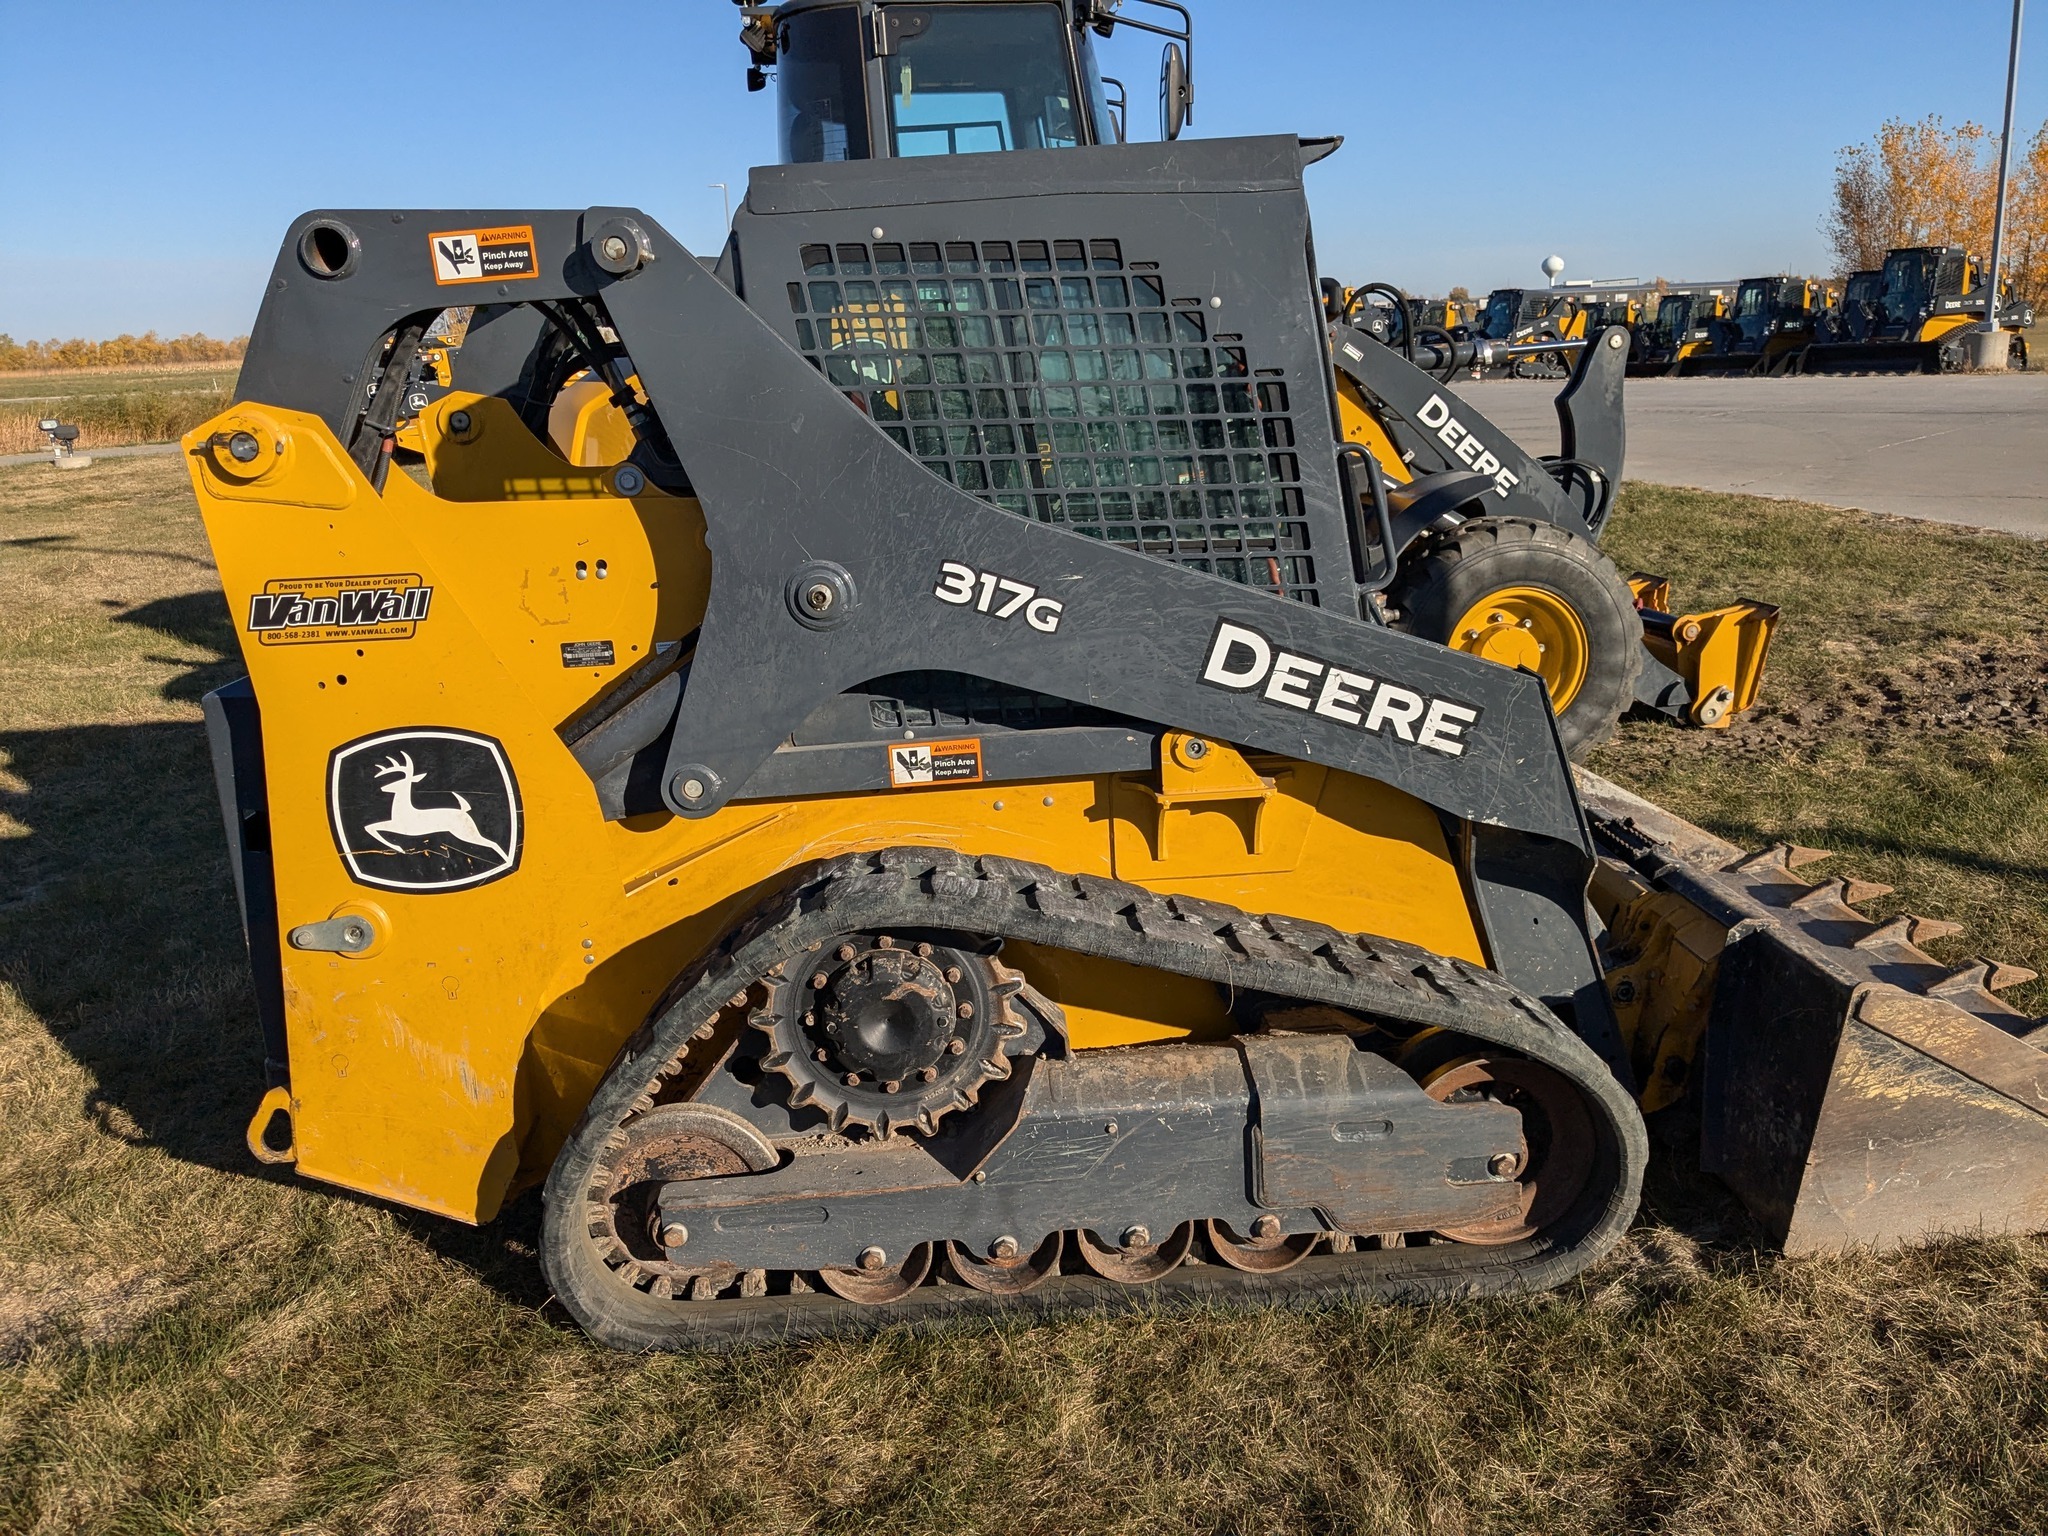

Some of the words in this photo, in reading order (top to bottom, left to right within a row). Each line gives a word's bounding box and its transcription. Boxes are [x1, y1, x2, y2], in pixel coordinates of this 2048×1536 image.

[488, 231, 527, 241] WARNING
[482, 251, 507, 260] Pinch
[508, 250, 529, 259] Area
[484, 263, 503, 271] Keep
[504, 261, 524, 270] Away
[1416, 393, 1520, 498] DEERE
[278, 583, 303, 591] PROUD
[383, 578, 409, 586] CHOICE
[935, 562, 1063, 633] 317G
[267, 630, 321, 640] 800-568-2381
[1203, 622, 1477, 756] DEERE
[942, 743, 976, 752] WARNING
[934, 760, 956, 768] Pinch
[957, 758, 975, 766] Area
[952, 768, 970, 776] Away
